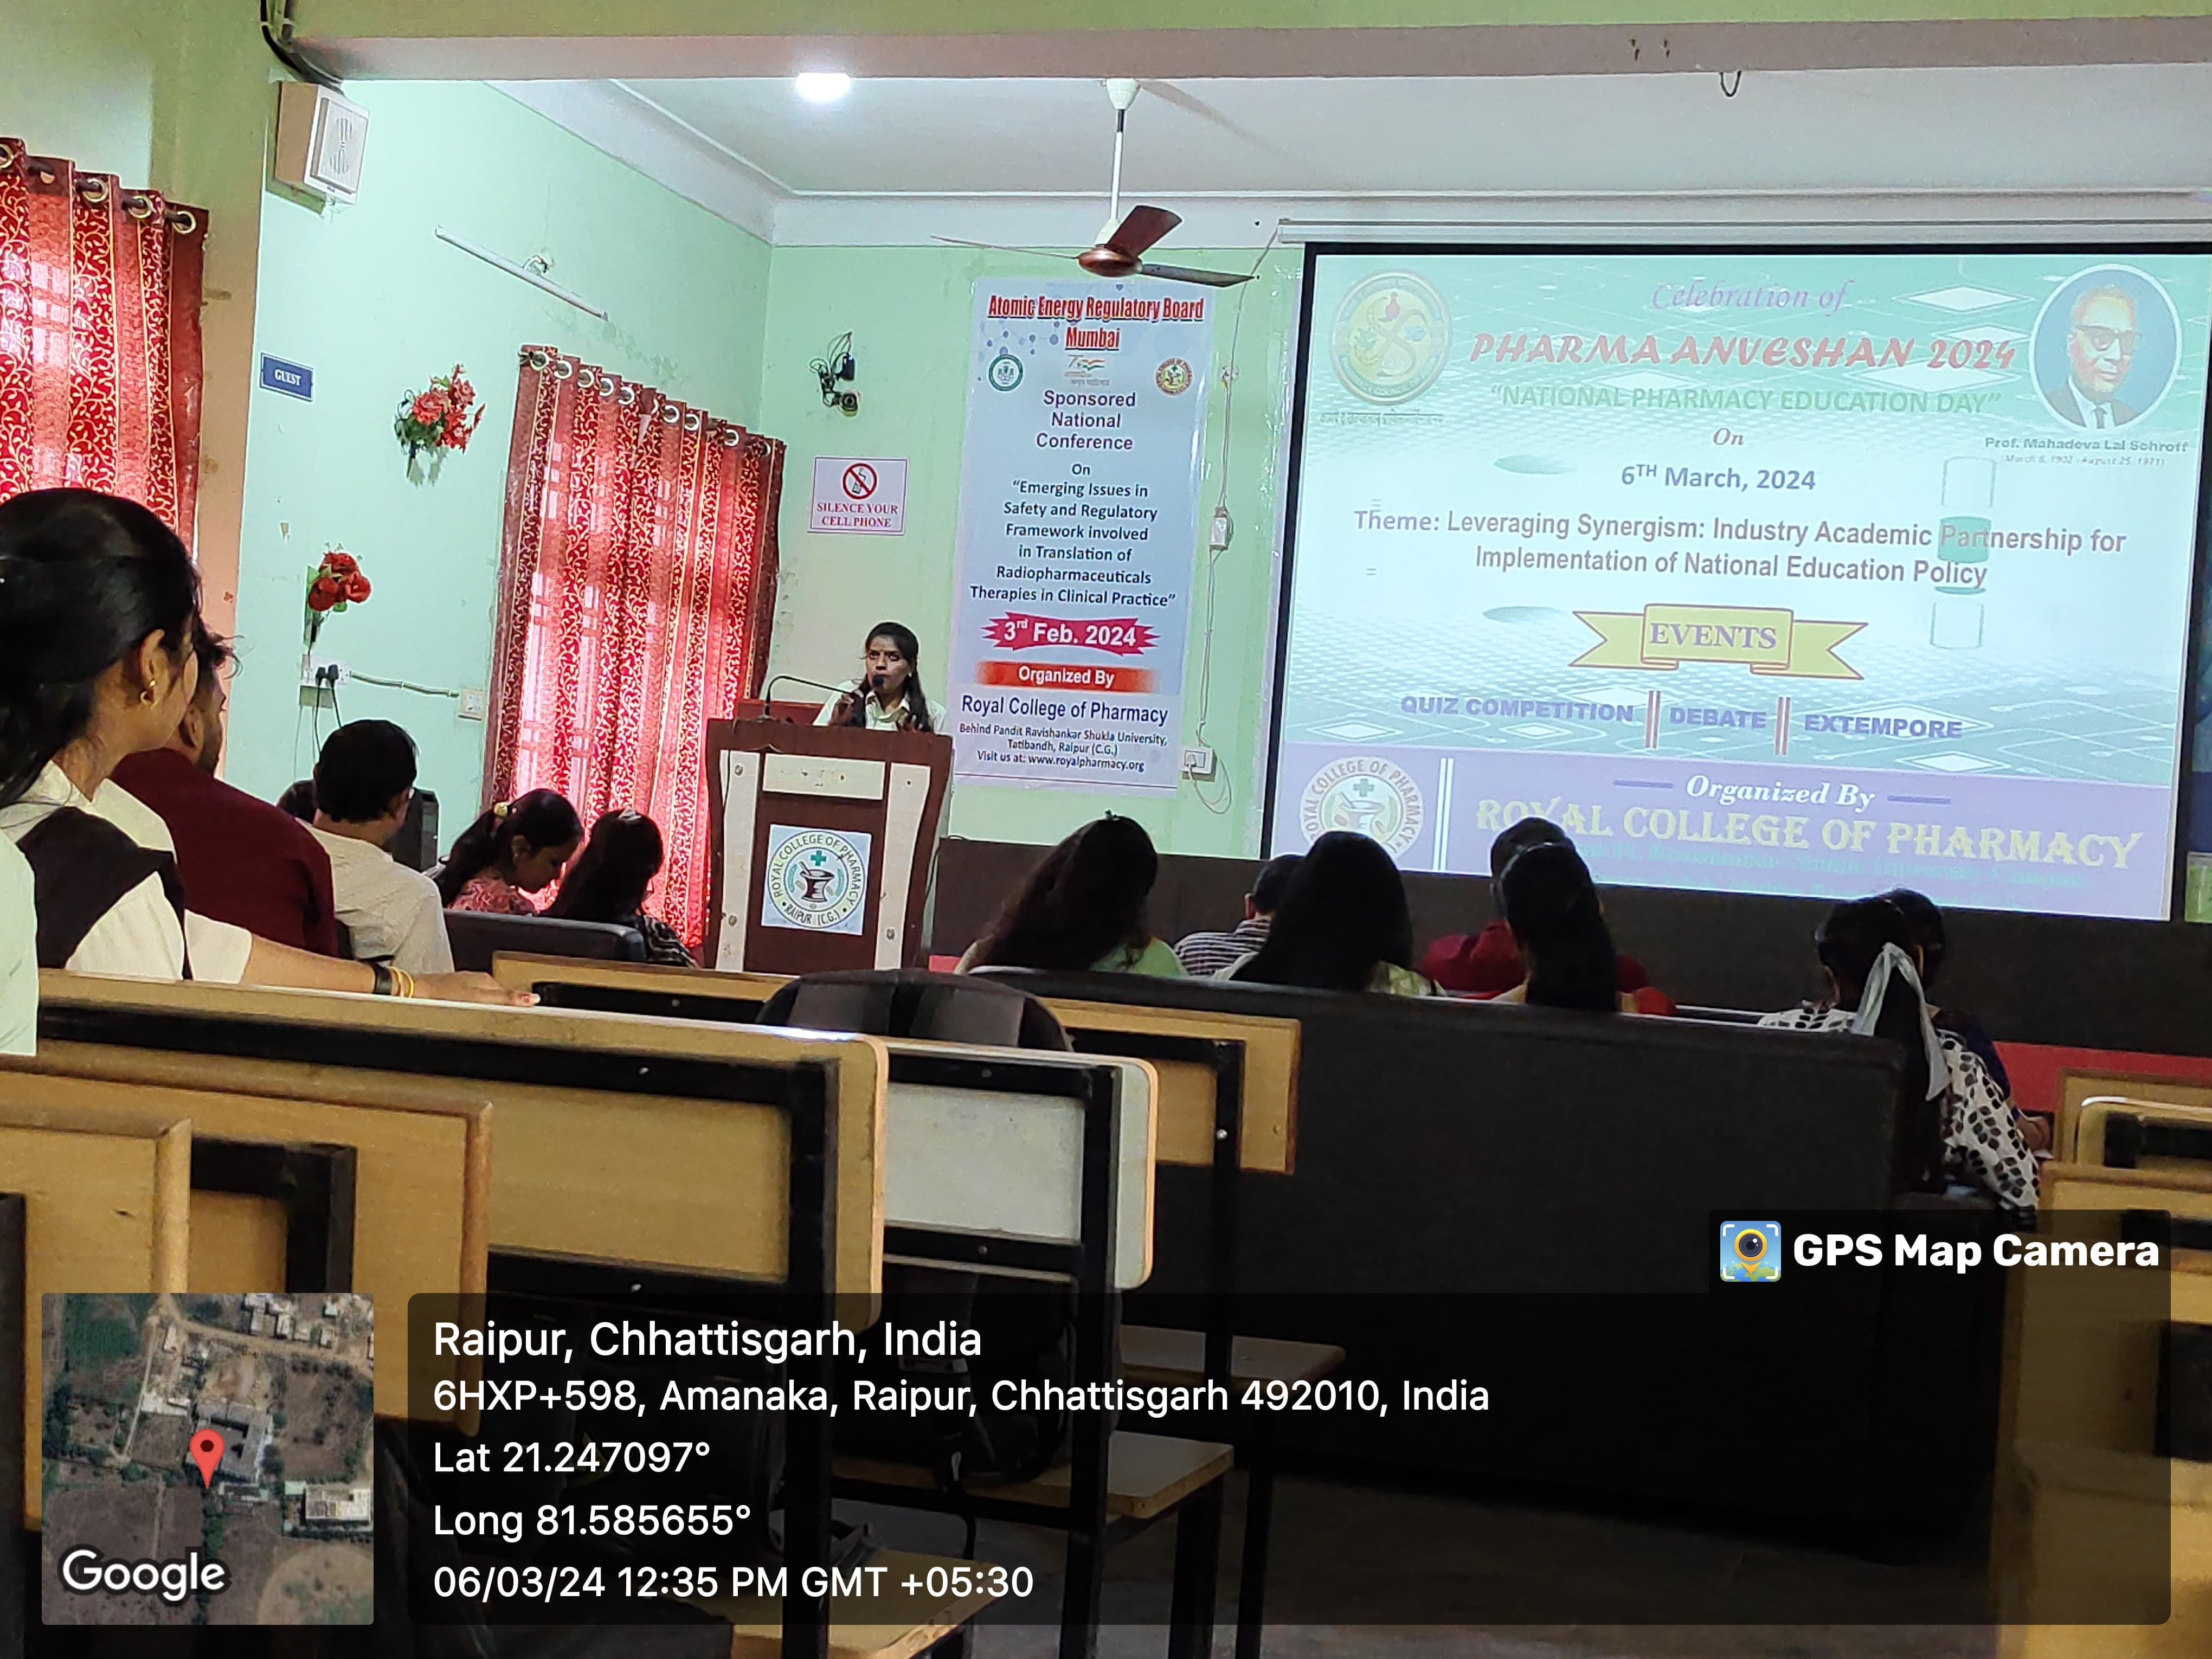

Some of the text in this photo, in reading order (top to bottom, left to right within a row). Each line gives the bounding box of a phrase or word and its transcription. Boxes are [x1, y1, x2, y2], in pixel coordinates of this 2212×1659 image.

[988, 295, 1204, 321] Atomic Energy Regulatory Board
[1652, 279, 1855, 317] Celebration of
[1065, 326, 1121, 348] Mumbai
[1470, 333, 2016, 370] PHARMA ANVESHAN 2024
[274, 369, 302, 386] GUEST
[1044, 391, 1136, 408] Sponsored
[1632, 387, 1772, 410] PHARMACY
[1781, 391, 1927, 413] EDUCATION
[1937, 392, 2002, 413] DAY”
[1051, 411, 1121, 428] National
[1037, 433, 1133, 450] Conference
[1713, 427, 1744, 446] On
[1985, 437, 2020, 448] Prof.
[2023, 439, 2100, 449] Mahadeva
[2105, 440, 2125, 450] Lal
[1072, 464, 1090, 475] On
[1621, 464, 1816, 492] 6TH March, 2024
[1089, 482, 1131, 497] Issues
[1136, 484, 1148, 497] in
[817, 501, 898, 515] SILENCE YOUR
[1004, 501, 1158, 522] Safety and Regulatory
[821, 516, 891, 528] CELL PHONE
[1006, 523, 1148, 541] Framework involved
[1354, 510, 2127, 556] Theme: Leveraging Synergism: Industry Academic Partnership for
[1019, 544, 1133, 562] in Translation of
[996, 565, 1152, 584] Radiopharmaceuticals
[1476, 545, 1988, 590] Implementation of National Education Policy
[970, 586, 1037, 602] Therapies
[1041, 589, 1053, 601] in
[1058, 589, 1107, 604] Clinical
[1004, 619, 1137, 647] 3rd Feb. 2024
[1650, 621, 1777, 650] EVENTS
[1019, 665, 1116, 689] Organized By
[961, 695, 1168, 727] Royal College of Pharmacy
[1400, 696, 1634, 722] QUIZ COMPETITION
[1670, 708, 1767, 729] DEBATE
[960, 723, 1168, 747] Behind Pandit Ravishankar Shukla University,
[1804, 713, 1963, 739] EXTEMPORE
[1059, 742, 1090, 754] Raipur
[1092, 743, 1118, 757] (C.G.)
[977, 750, 998, 761] Visit
[1013, 754, 1026, 763] at:
[1028, 755, 1145, 773] www.royalpharmacy.org
[1311, 759, 1364, 795] COLLEGE
[1369, 760, 1389, 775] OF
[1388, 769, 1420, 844] PHARMACY
[1686, 774, 1875, 813] Organized By
[1624, 806, 1809, 850] COLLEGE
[1822, 819, 1876, 852] OF
[1887, 822, 2145, 869] PHARMACY
[770, 834, 861, 906] ROYAL COLLEGE OF PHARMACY
[784, 903, 813, 924] RAIPUR
